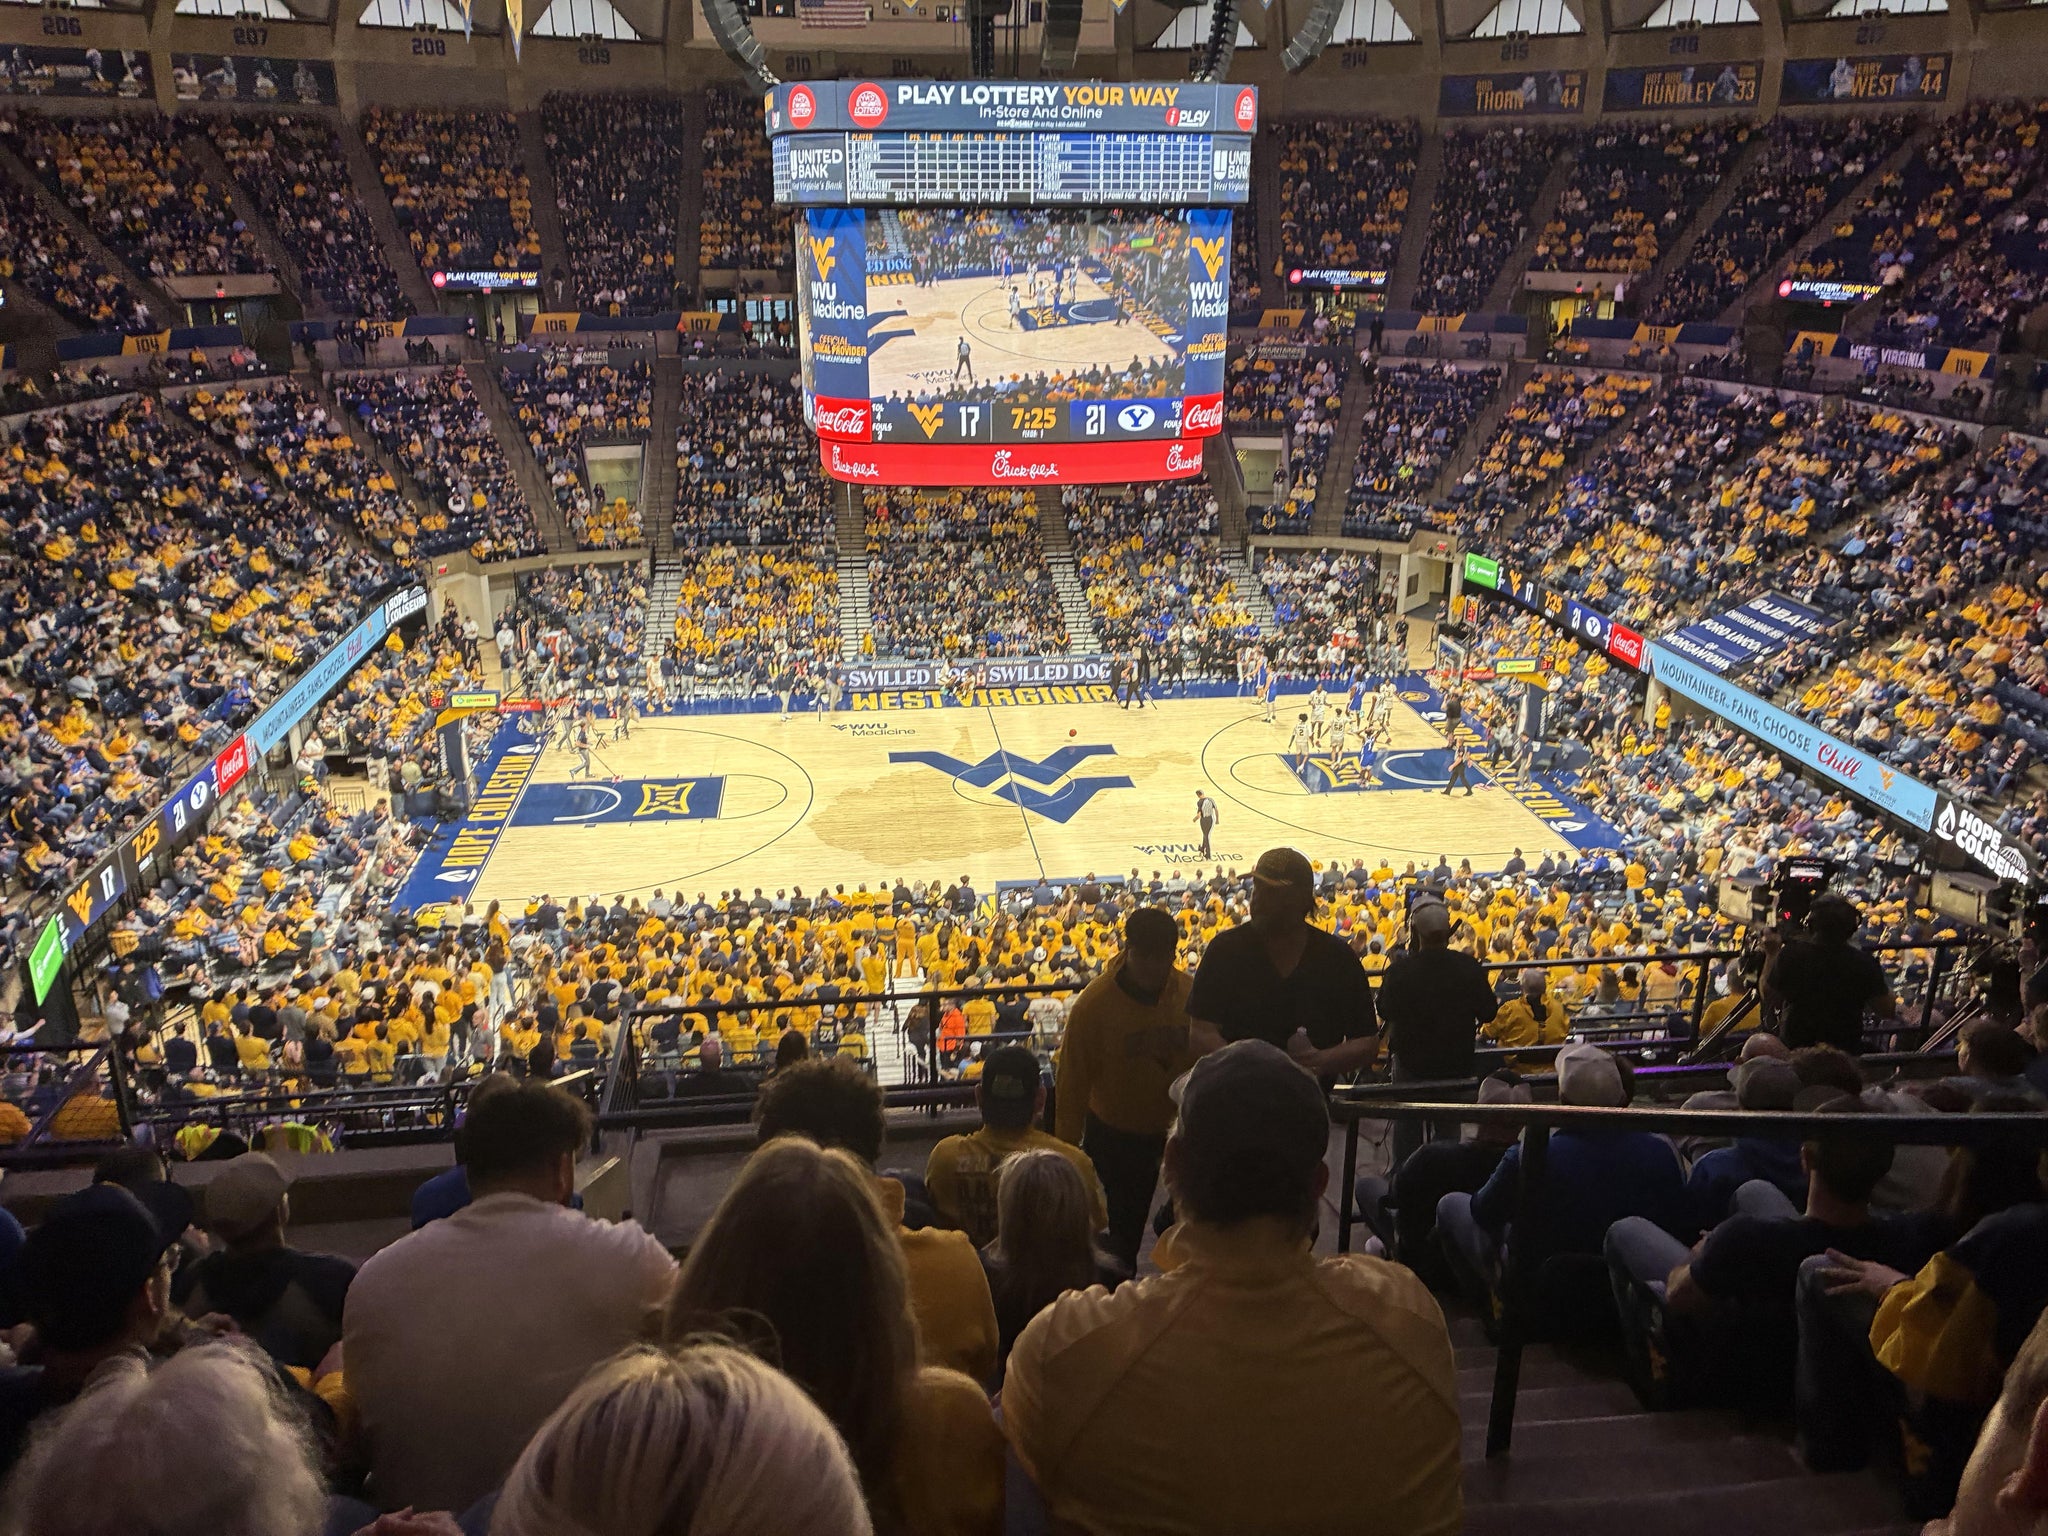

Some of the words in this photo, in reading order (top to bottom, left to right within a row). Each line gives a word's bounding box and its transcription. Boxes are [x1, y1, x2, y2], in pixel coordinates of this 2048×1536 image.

[42, 16, 82, 36] 206
[233, 28, 267, 45] 207
[411, 38, 446, 55] 208
[1641, 81, 1716, 104] HUNDLEY
[1734, 79, 1756, 101] 33
[1850, 73, 1899, 98] WEST
[1919, 72, 1942, 95] 44
[897, 85, 956, 105] PLAY
[960, 85, 1059, 106] LOTTERY
[1063, 86, 1124, 106] YOUR
[1129, 86, 1180, 106] WAY
[1476, 90, 1524, 111] THORN
[1561, 86, 1579, 108] 44
[854, 107, 883, 117] LOTTERY
[979, 105, 1030, 120] In-Store
[1032, 105, 1058, 119] And
[1061, 105, 1103, 119] Online
[851, 133, 873, 141] PLAYER
[1038, 134, 1060, 142] PLAYER
[798, 149, 844, 164] UNITED
[798, 164, 829, 179] BANK
[825, 180, 843, 191] Bank
[851, 191, 867, 199] FIELD
[1036, 191, 1051, 200] FIELD
[886, 258, 912, 272] DOG
[1302, 269, 1321, 279] PLAY
[1320, 270, 1350, 280] LOTTERY
[1350, 271, 1369, 280] YOUR
[1369, 271, 1387, 280] WAY
[446, 272, 465, 281] PLAY
[466, 271, 499, 280] LOTTERY
[499, 272, 520, 280] YOUR
[520, 271, 538, 280] WAY
[811, 281, 837, 300] WVU
[1190, 281, 1223, 300] WVU
[1791, 282, 1810, 291] PLAY
[1810, 282, 1842, 293] LOTTERY
[1842, 283, 1862, 293] YOUR
[545, 320, 567, 332] 106
[690, 319, 711, 331] 107
[1434, 318, 1447, 330] 111
[135, 338, 160, 353] 104
[832, 344, 867, 357] PROVIDER
[1881, 347, 1926, 369] VIRGINIA
[1956, 358, 1972, 374] 114
[816, 404, 867, 434] Coca-Cola
[959, 405, 980, 437] 17
[1010, 406, 1057, 431] 7:25
[1085, 404, 1106, 436] 21
[1125, 408, 1149, 428] Y
[832, 444, 879, 477] Chick-fil-A
[992, 449, 1059, 478] Chick-fil-A
[389, 589, 409, 610] HOPE
[1525, 581, 1534, 603] 17
[1545, 590, 1562, 614] 7:25
[390, 592, 428, 622] COLISEUM
[1571, 607, 1582, 631] 21
[1699, 617, 1732, 636] FORD
[1613, 633, 1640, 659] Coca-Cola
[1662, 632, 1731, 671] MORGANTOWN
[1704, 641, 1719, 650] OF
[323, 652, 346, 682] CHOOSE
[848, 668, 930, 688] SWILLED
[988, 664, 1069, 683] SWILLED
[1073, 662, 1112, 681] DOG
[852, 689, 944, 711] WEST
[954, 685, 1114, 708] VIRGINIA
[1659, 660, 1727, 706] MOUNTAINEER
[1731, 700, 1761, 731] FANS,
[1762, 716, 1811, 753] CHOOSE
[1817, 743, 1863, 781] Chill
[852, 728, 916, 737] Medicine
[221, 745, 244, 783] Coca-Cola
[467, 754, 537, 821] COLISEUM
[172, 798, 186, 832] 21
[1959, 809, 2003, 851] HOPE
[131, 819, 160, 863] 7:25
[441, 826, 501, 867] HOPE
[1154, 843, 1202, 853] WVU
[1955, 829, 2029, 886] COLISEUM
[99, 865, 116, 902] 17
